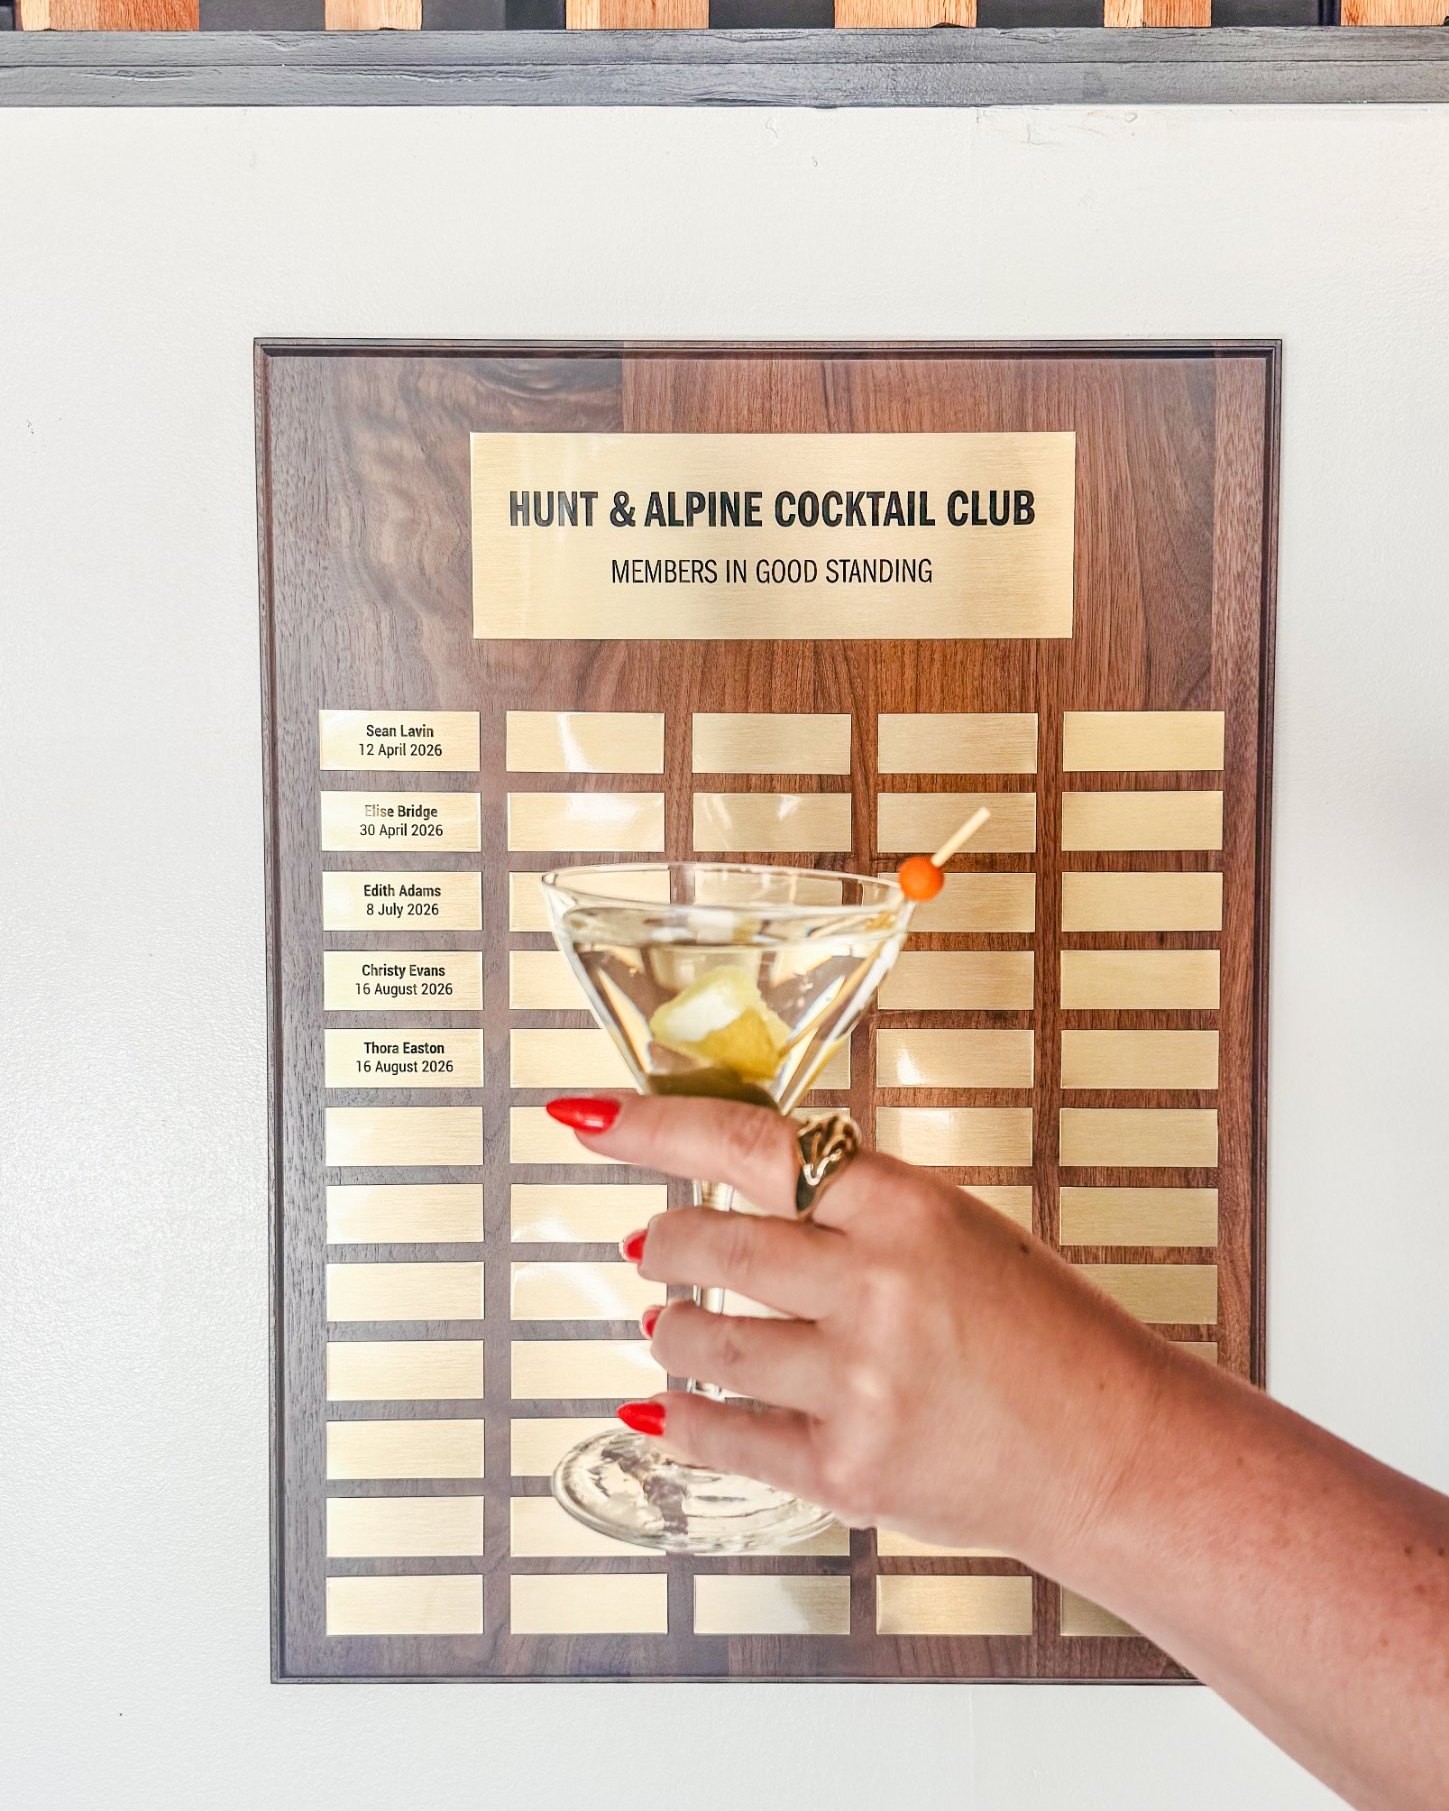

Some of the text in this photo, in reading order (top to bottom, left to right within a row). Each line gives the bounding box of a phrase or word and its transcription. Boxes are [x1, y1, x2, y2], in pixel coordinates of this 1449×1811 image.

[510, 489, 1036, 527] HUNT & ALPINE COCKTAIL CLUB
[611, 558, 933, 583] MEMBERS IN GOOD STANDING
[366, 723, 434, 738] Sean Lavin
[359, 742, 443, 759] 12 April 2026
[365, 804, 438, 821] Elise Bridge
[359, 822, 444, 839] 30 April 2026
[364, 883, 442, 897] Edith Adams
[366, 902, 439, 919] 8 July 2026
[361, 963, 446, 980] Christy Evans
[355, 982, 453, 999] 16 August 2026
[363, 1041, 445, 1054] Thora Easton
[356, 1060, 454, 1076] 16 August 2026
